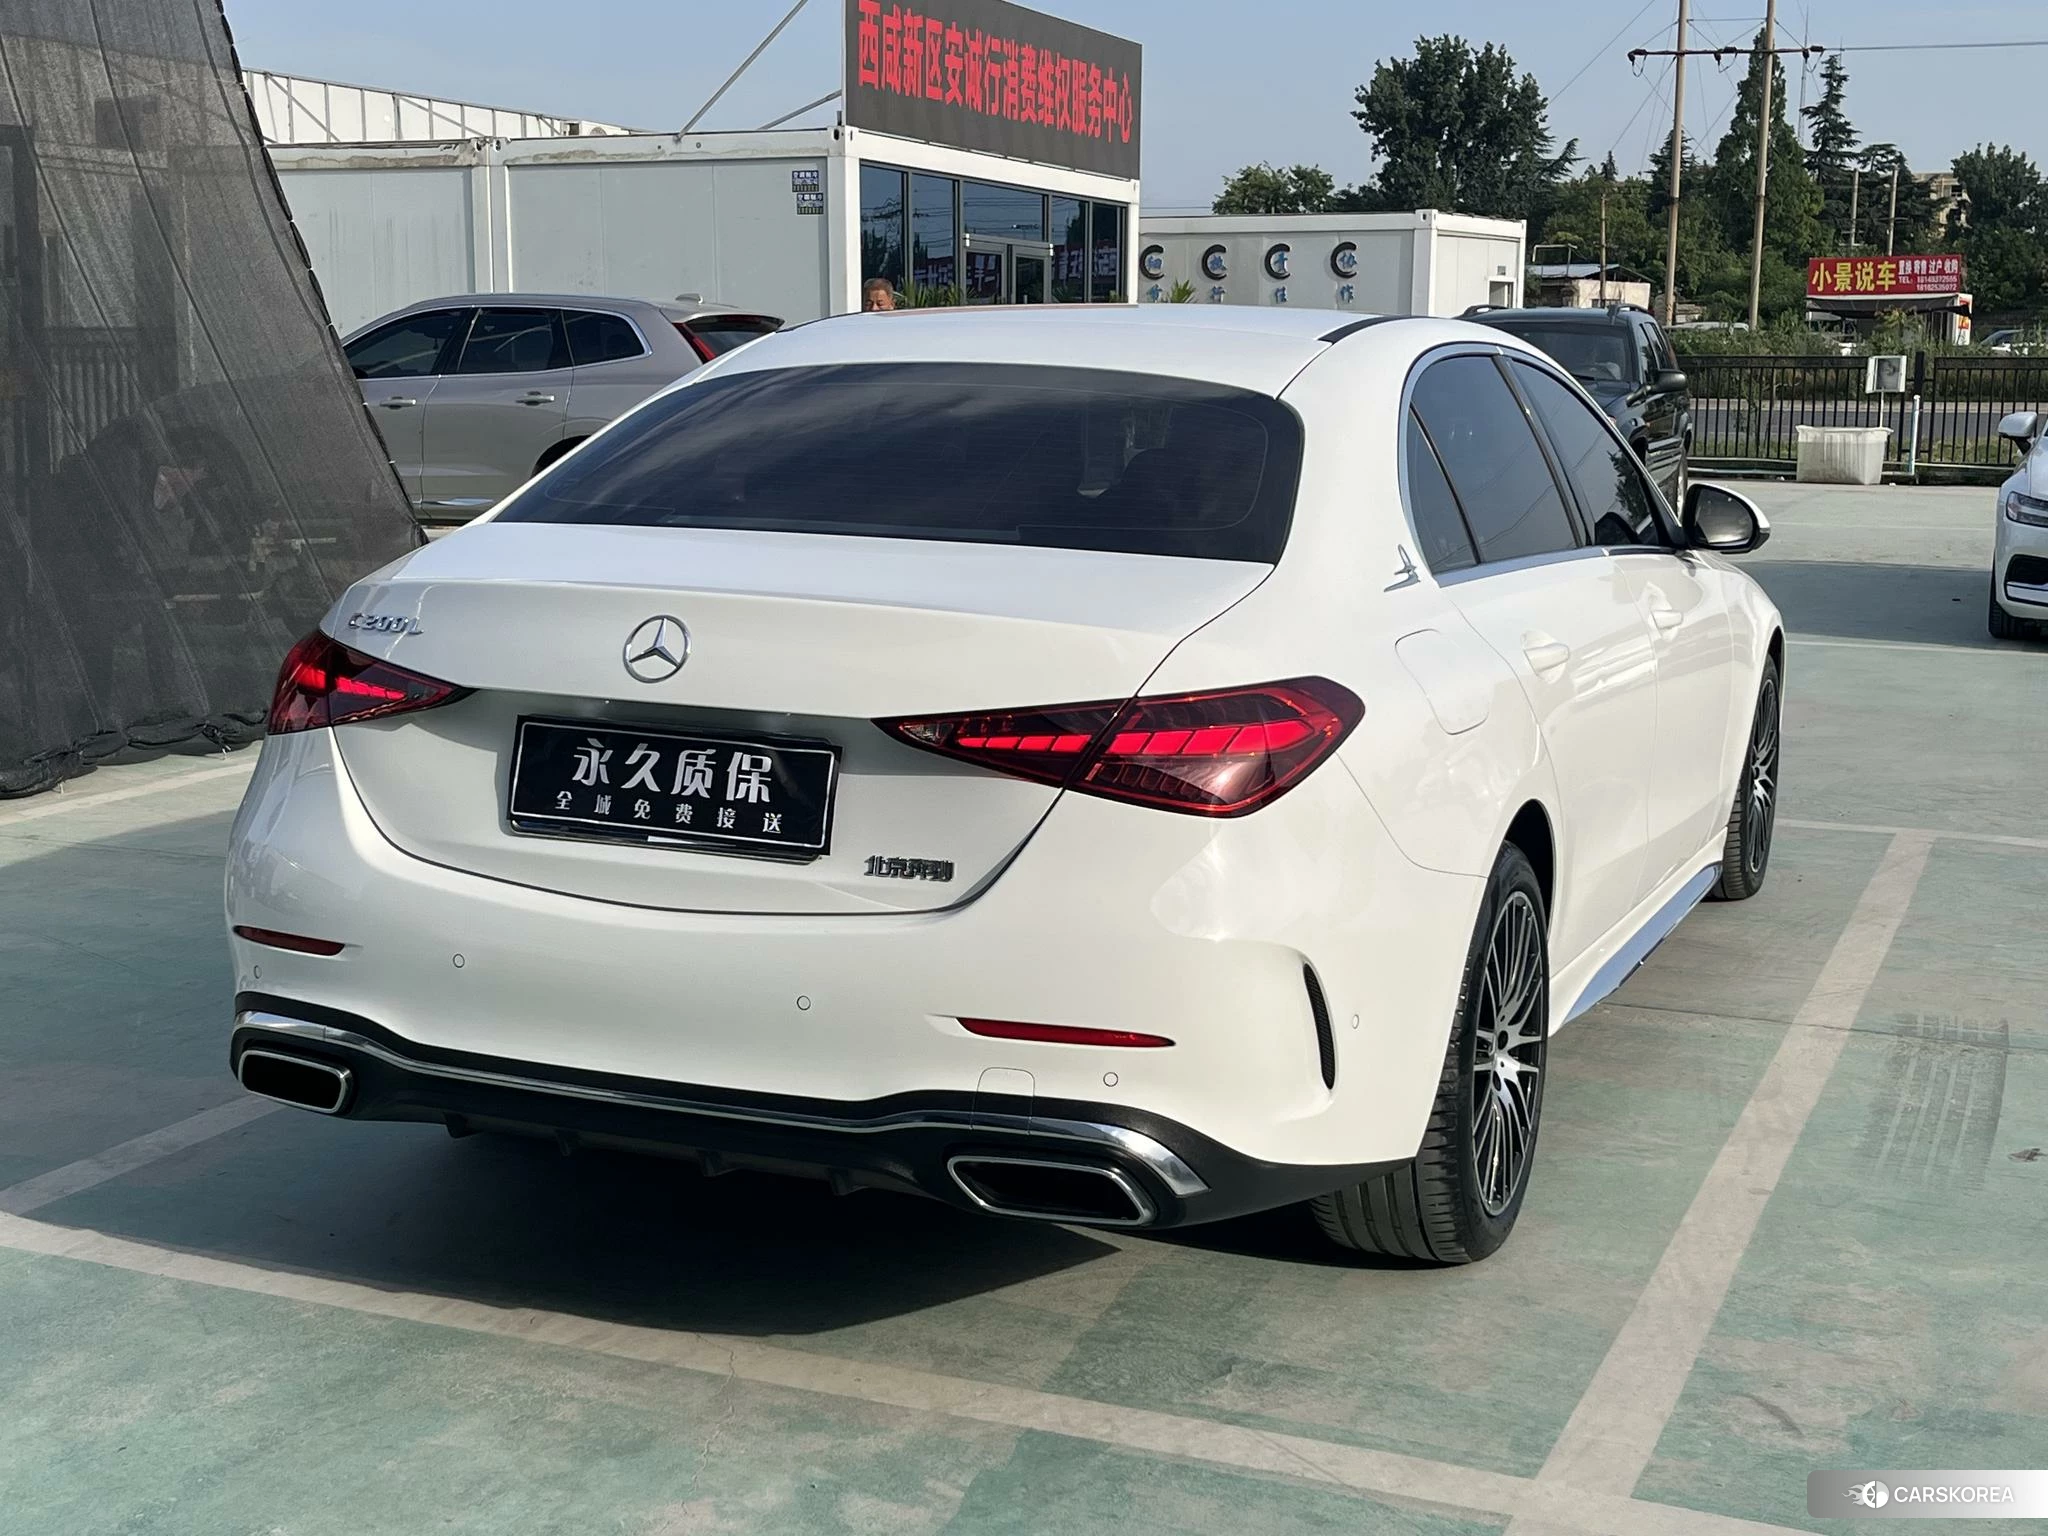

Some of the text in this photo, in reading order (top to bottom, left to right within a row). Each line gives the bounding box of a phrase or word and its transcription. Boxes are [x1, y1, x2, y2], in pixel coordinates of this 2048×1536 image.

[858, 0, 1133, 144] 西咸新区安诚行消费维权服务中心
[1812, 260, 1897, 292] 小景说车
[1928, 259, 1942, 274] 过户
[572, 738, 773, 804] 永久质保
[555, 790, 782, 834] 全城免费接送
